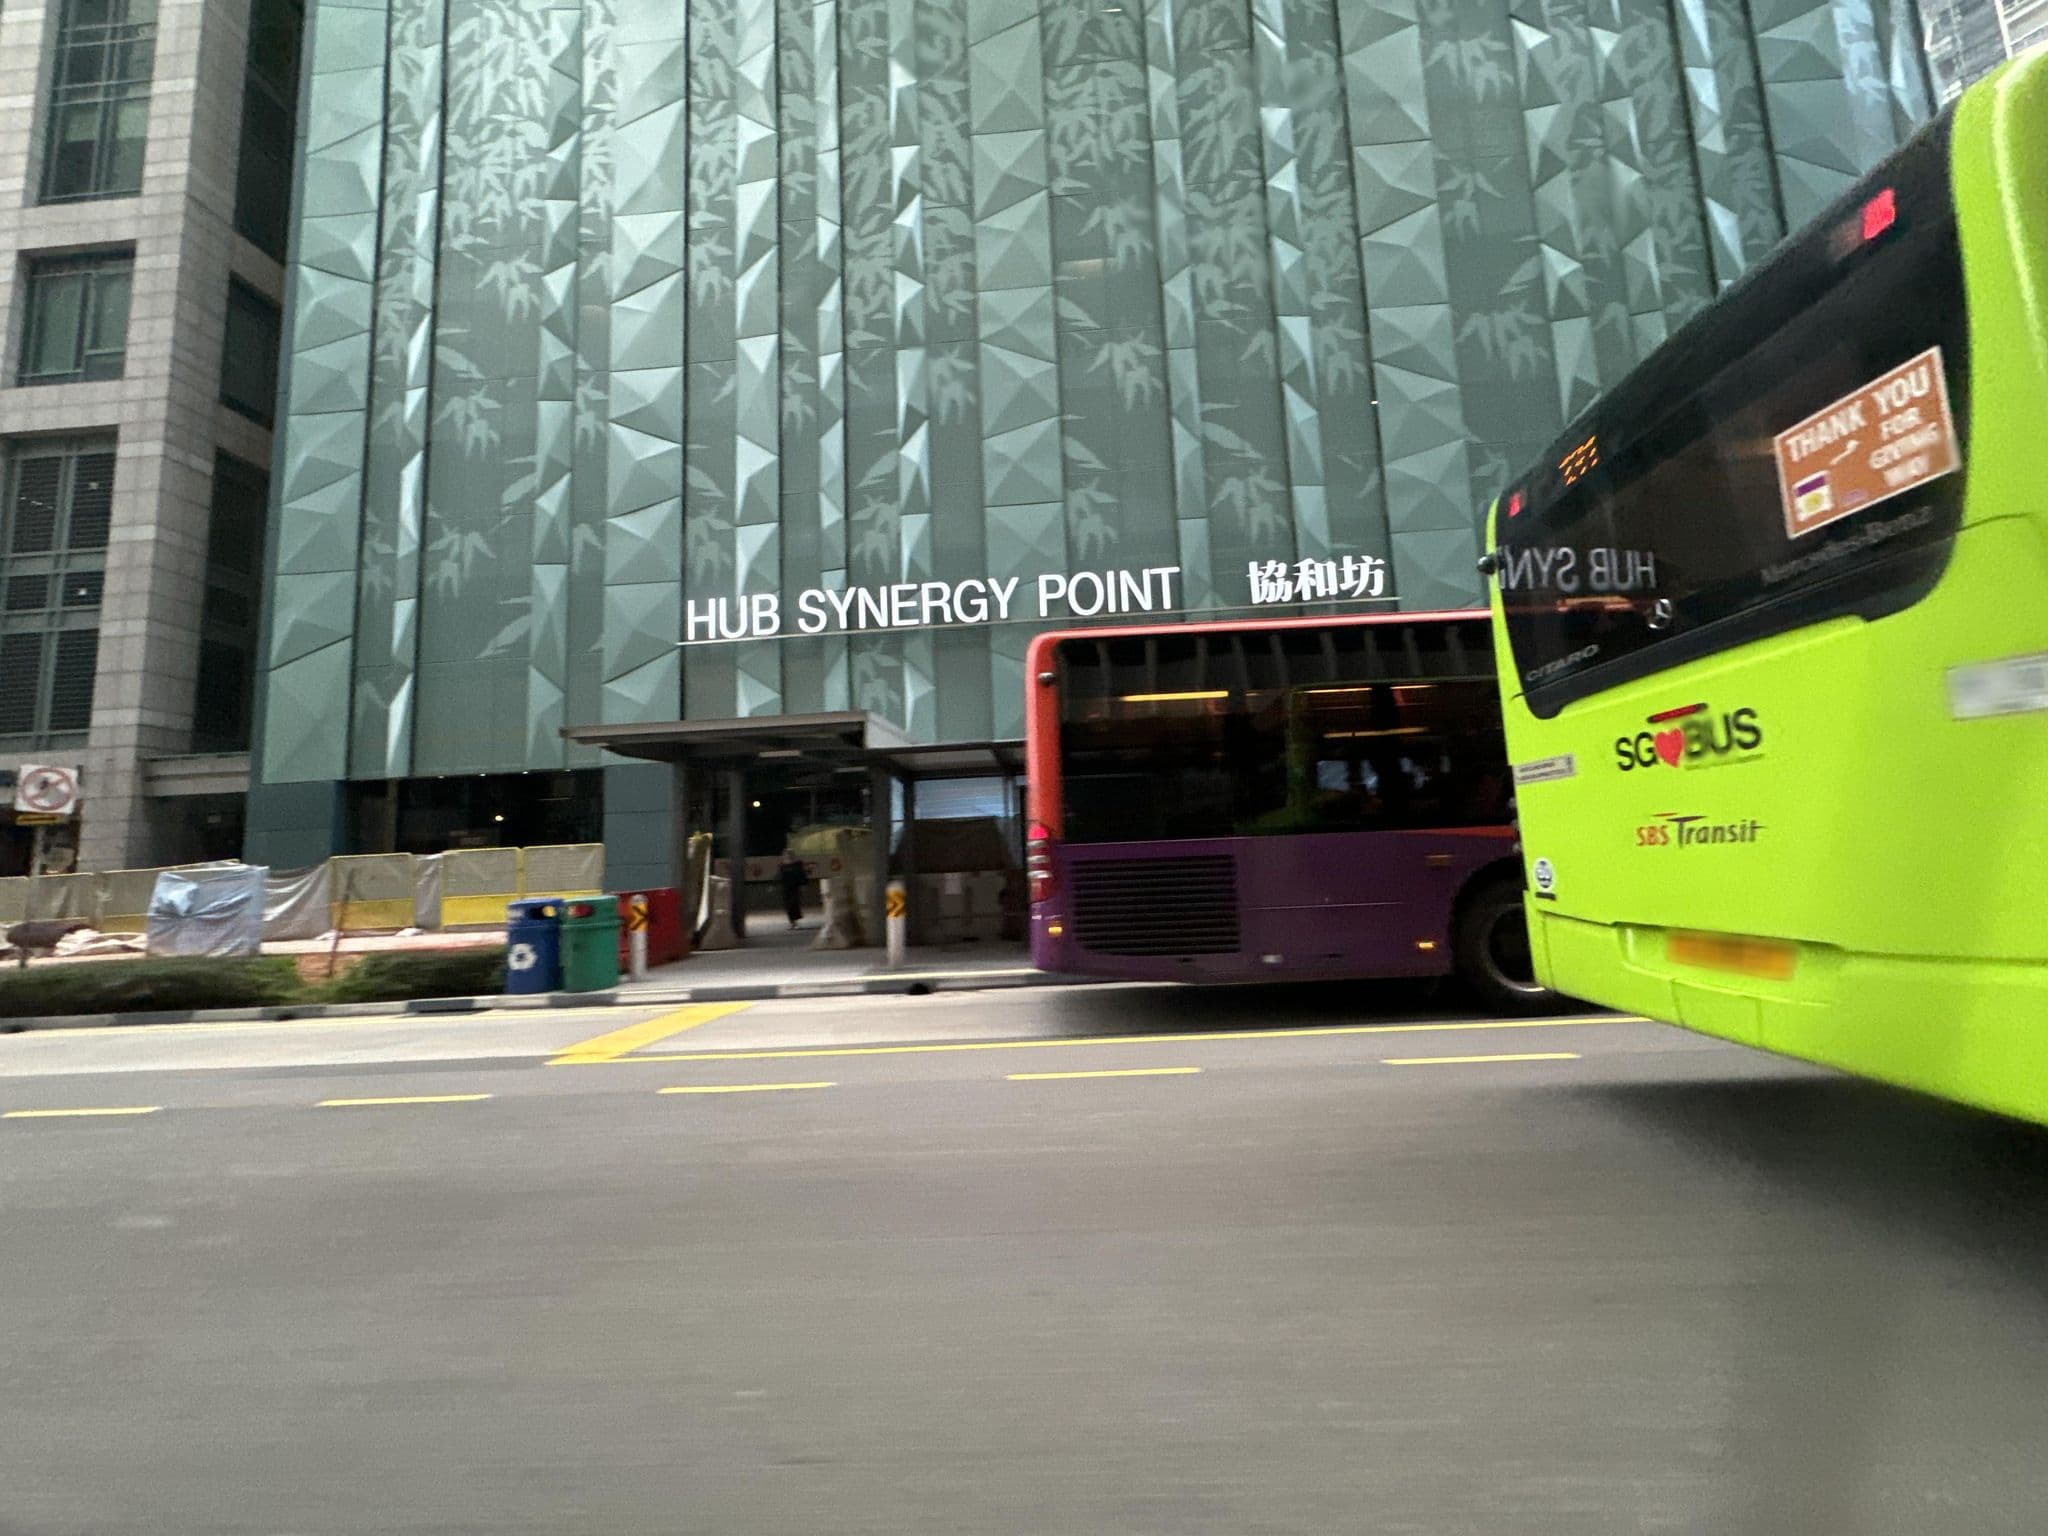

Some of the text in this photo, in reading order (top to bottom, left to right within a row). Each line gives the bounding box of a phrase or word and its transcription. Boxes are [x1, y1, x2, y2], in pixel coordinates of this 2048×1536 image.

[1785, 365, 1931, 463] THANK YOU
[1879, 406, 1923, 441] FOR
[687, 566, 1181, 641] HUB SYNERGY POINT
[1246, 555, 1386, 605] 協和坊
[1636, 815, 1768, 849] SBS Transit
